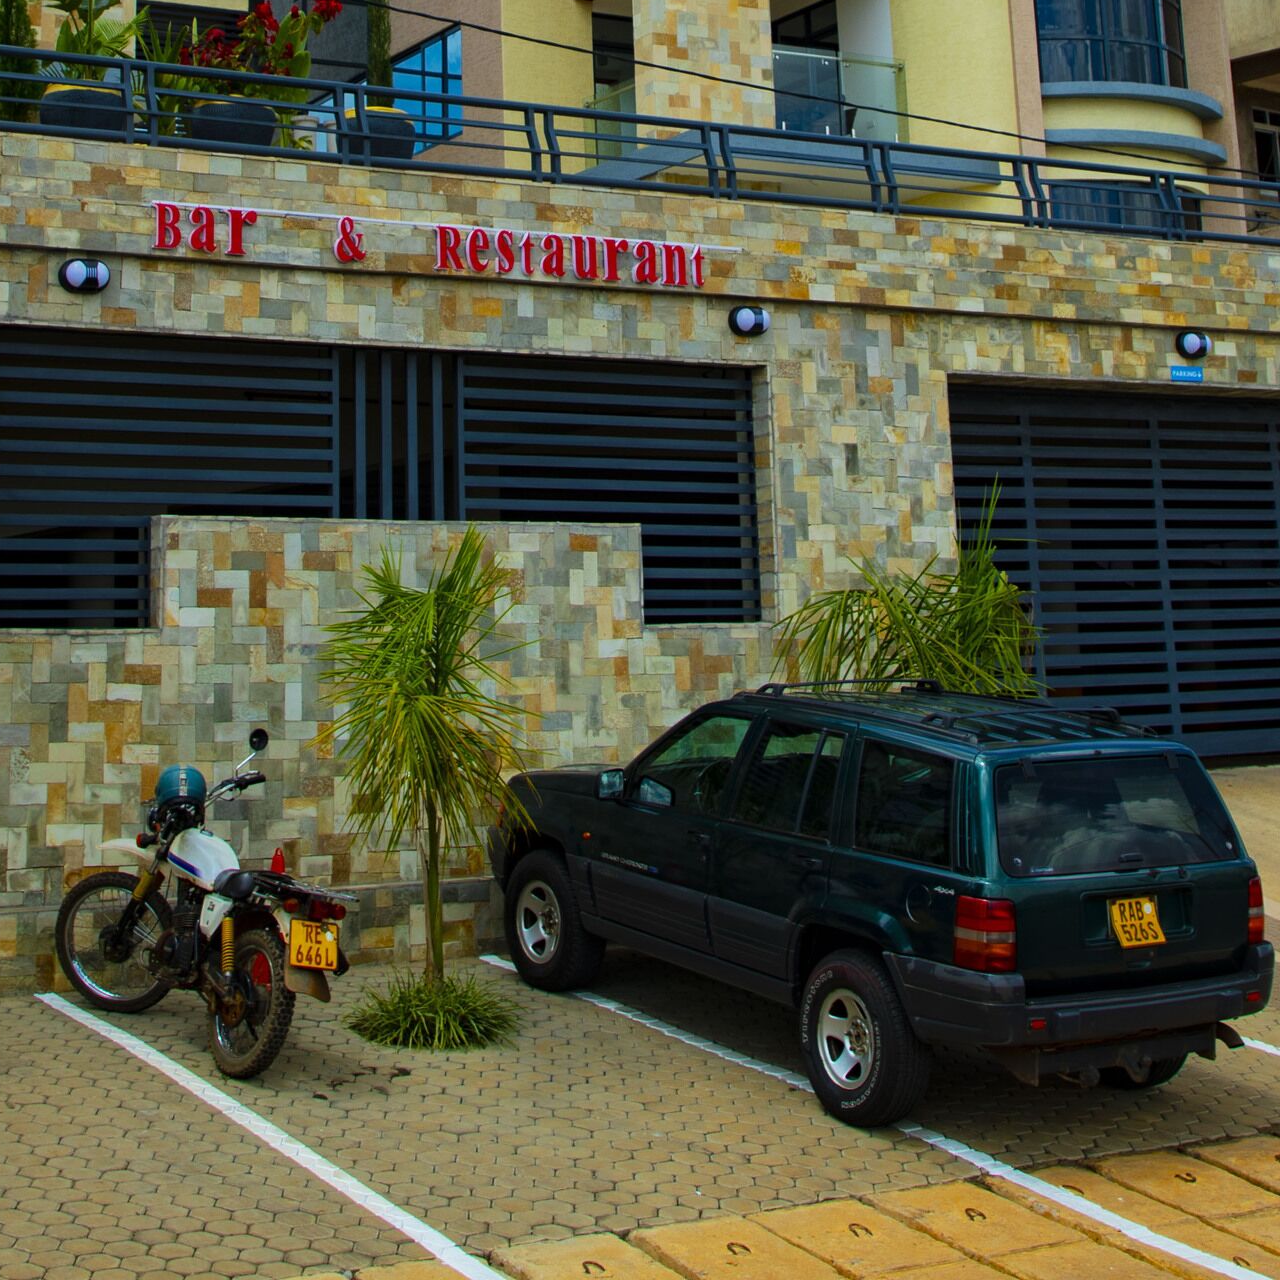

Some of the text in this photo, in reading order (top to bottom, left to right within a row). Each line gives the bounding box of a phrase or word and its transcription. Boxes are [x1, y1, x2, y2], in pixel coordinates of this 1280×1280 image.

[152, 202, 706, 288] Bar & Restaurant
[1172, 370, 1197, 378] PARKING
[1118, 900, 1145, 923] RAB
[303, 923, 322, 945] RE
